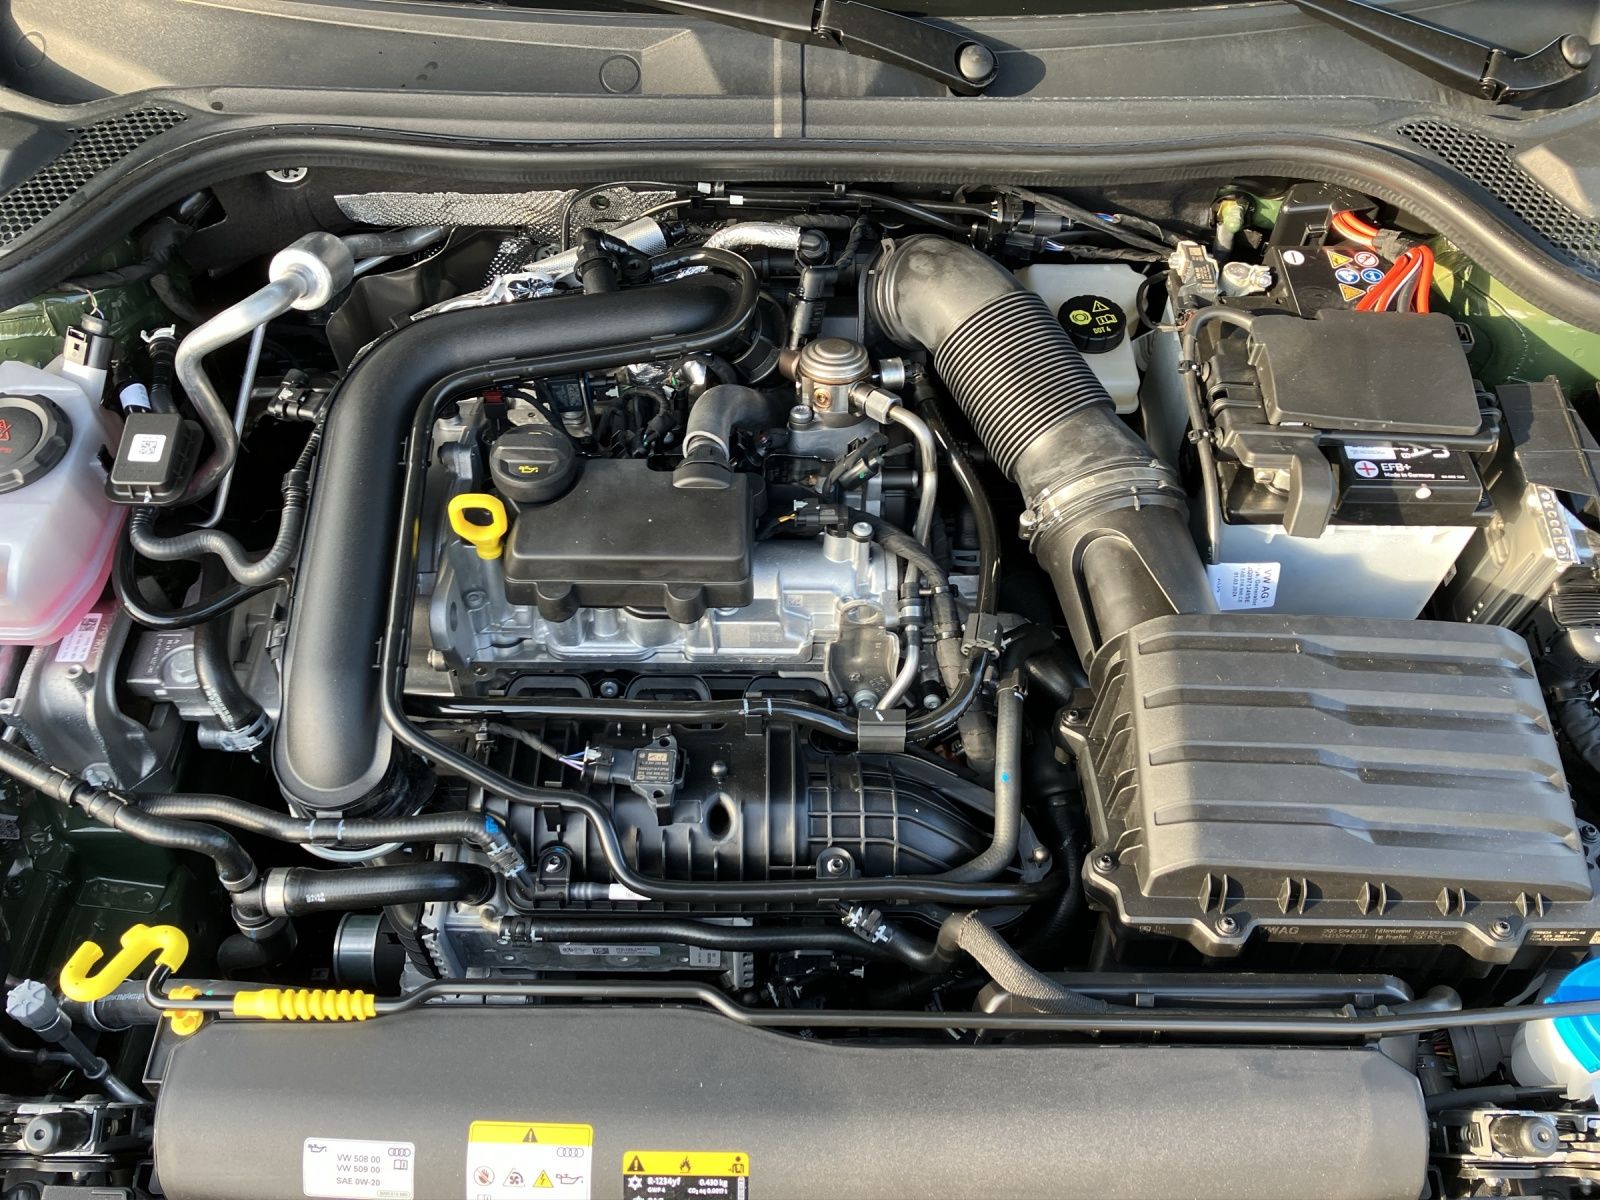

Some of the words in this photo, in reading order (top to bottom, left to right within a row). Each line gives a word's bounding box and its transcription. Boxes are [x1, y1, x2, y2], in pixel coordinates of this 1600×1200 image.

[1380, 462, 1412, 472] EFB+
[1264, 569, 1272, 584] VW
[1261, 586, 1270, 599] AG
[336, 1154, 352, 1162] VW
[353, 1155, 369, 1163] 508
[370, 1156, 381, 1164] 00
[336, 1164, 352, 1172] VW
[353, 1165, 369, 1173] 509
[370, 1166, 381, 1174] 00
[336, 1177, 353, 1185] SAE
[355, 1178, 381, 1186] 0W-20
[647, 1177, 681, 1187] R-1234yf
[719, 1179, 728, 1188] kg
